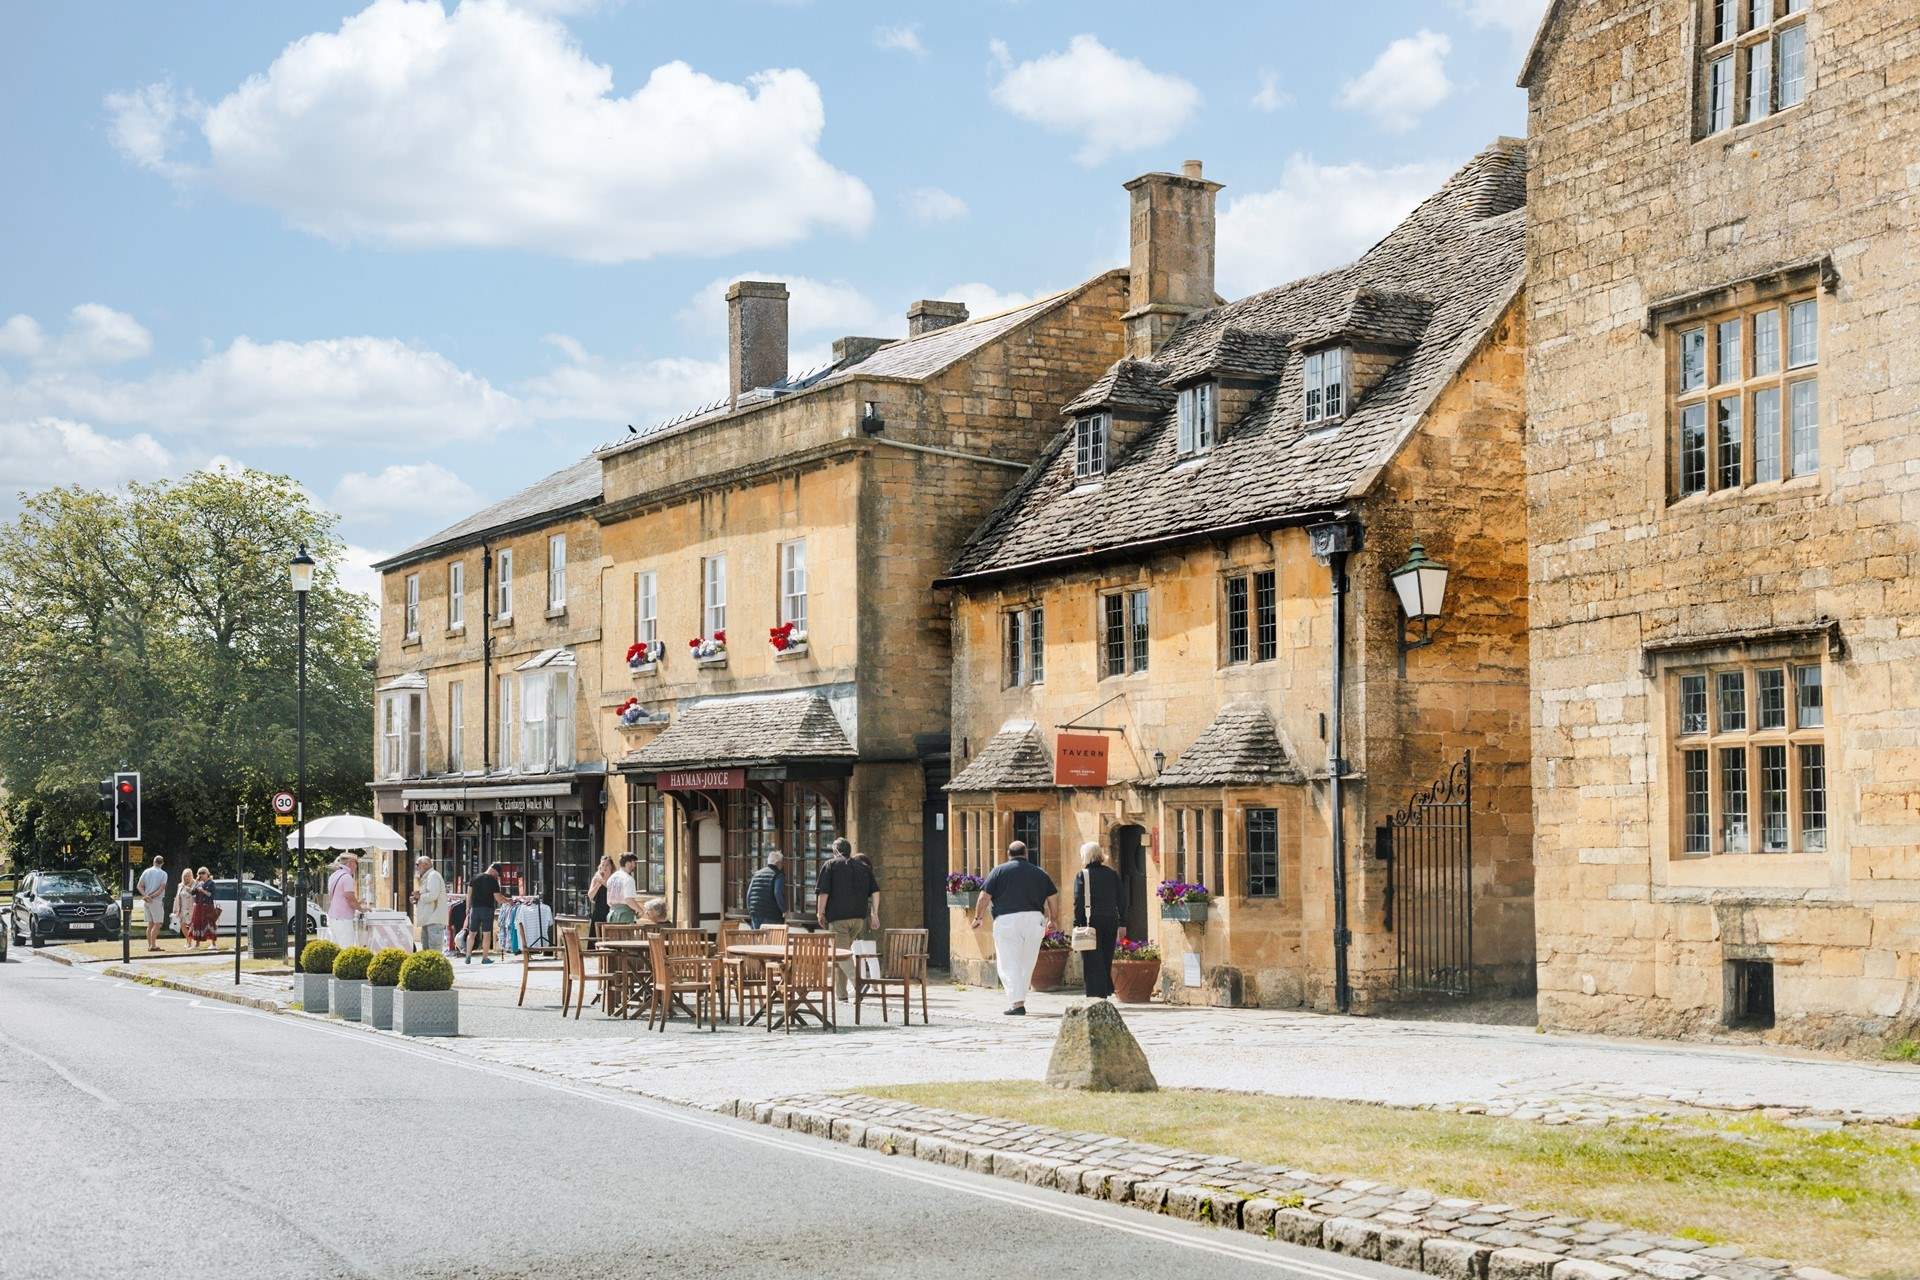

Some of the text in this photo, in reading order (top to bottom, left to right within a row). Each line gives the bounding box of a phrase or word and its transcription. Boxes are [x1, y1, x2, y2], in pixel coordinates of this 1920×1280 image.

[1062, 749, 1104, 757] TAVERN
[670, 772, 729, 788] HAYMAN-JOYCE
[278, 799, 292, 807] 30
